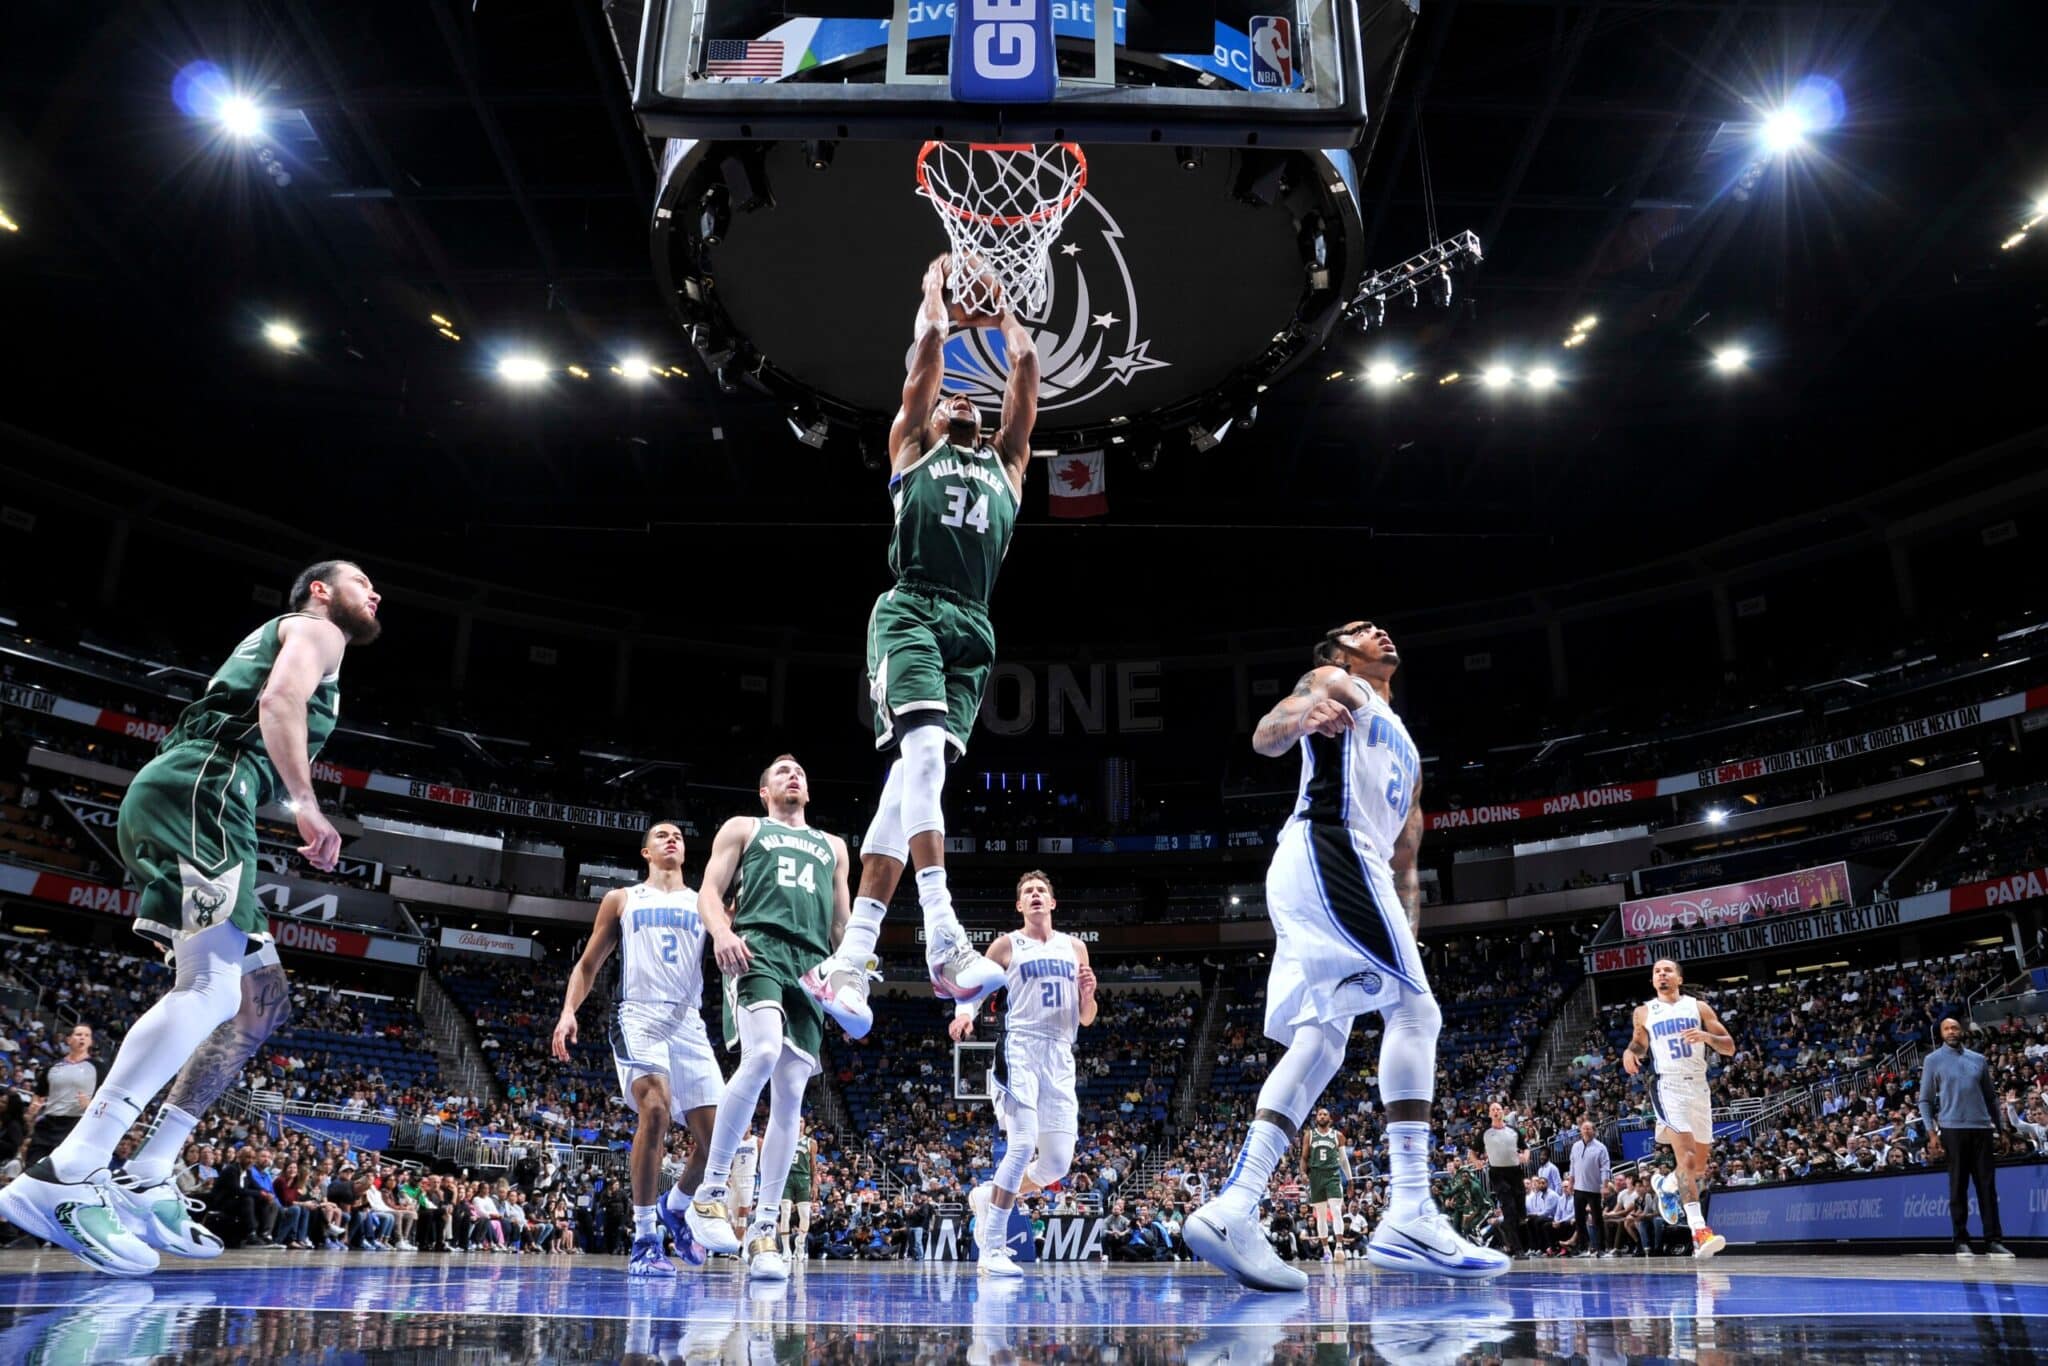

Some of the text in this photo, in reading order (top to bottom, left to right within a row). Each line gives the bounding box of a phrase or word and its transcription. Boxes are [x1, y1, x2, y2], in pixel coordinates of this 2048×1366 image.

[1257, 70, 1278, 85] NBA
[941, 485, 989, 534] 34
[1763, 753, 1793, 772] YOUR
[1793, 746, 1830, 767] ENTIRE
[1831, 734, 1869, 759] ONLINE
[1868, 726, 1905, 750] ORDER
[1904, 719, 1929, 741] THE
[1929, 712, 1960, 735] NEXT
[1959, 704, 1981, 727] DAY
[472, 791, 499, 810] YOUR
[499, 794, 533, 816] ENTIRE
[1543, 793, 1581, 815] PAPA
[1433, 811, 1471, 830] PAPA
[985, 839, 1006, 852] 4:30
[777, 855, 816, 894] 24
[69, 886, 122, 915] PAPA
[1748, 886, 1800, 911] World
[1984, 871, 2045, 907] PAPA
[632, 906, 701, 939] MAGIC
[1595, 949, 1624, 971] 50%
[1624, 945, 1648, 967] OFF
[1648, 940, 1683, 964] YOUR
[1683, 933, 1726, 959] ENTIRE
[1727, 925, 1769, 954] ONLINE
[1770, 918, 1813, 946] ORDER
[1814, 913, 1839, 938] THE
[1839, 907, 1873, 933] NEXT
[1874, 901, 1901, 927] DAY
[660, 933, 678, 965] 2
[1019, 958, 1075, 985] MAGIC
[1040, 981, 1062, 1008] 21
[1667, 1037, 1693, 1060] 50
